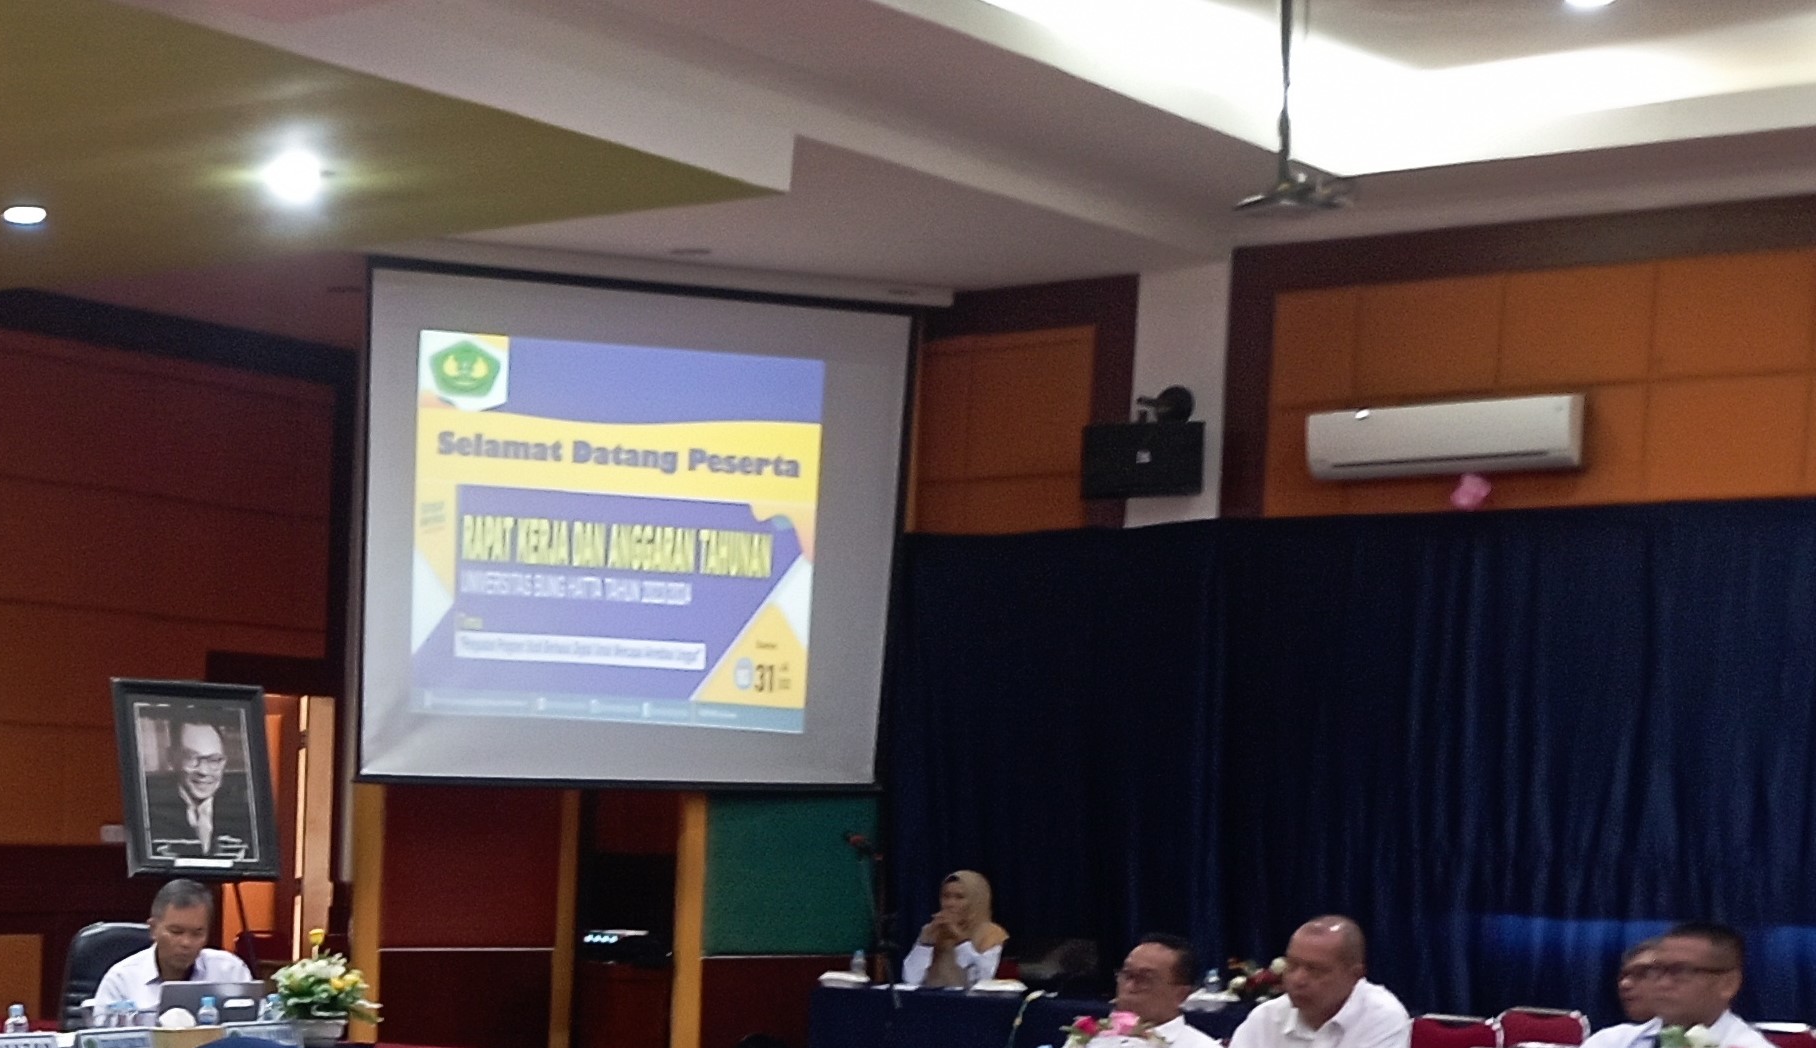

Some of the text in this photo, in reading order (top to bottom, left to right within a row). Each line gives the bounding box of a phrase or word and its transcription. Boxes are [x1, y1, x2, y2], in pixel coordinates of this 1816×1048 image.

[437, 430, 801, 478] Selamat Datang Peserta
